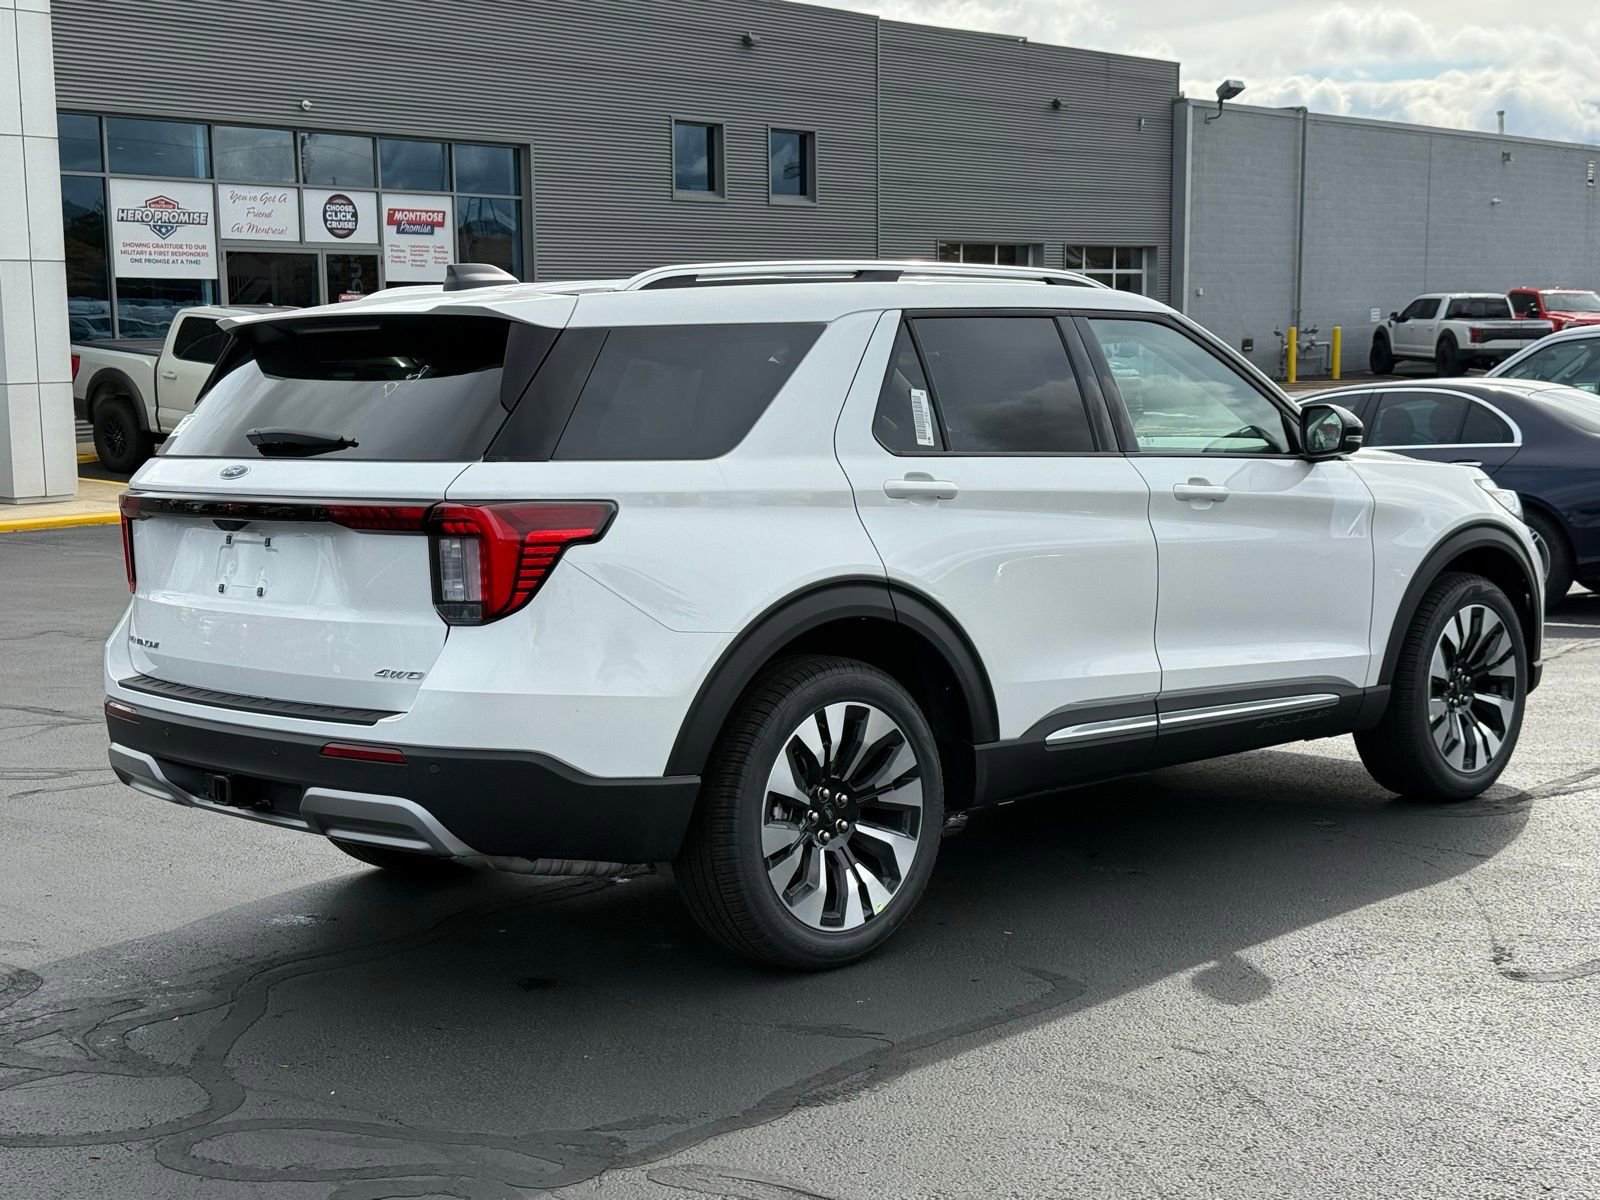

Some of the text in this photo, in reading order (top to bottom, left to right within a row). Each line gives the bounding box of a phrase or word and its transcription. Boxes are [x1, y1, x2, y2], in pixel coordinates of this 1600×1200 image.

[117, 208, 208, 225] HERO PROMISE
[246, 206, 274, 218] Friend
[326, 212, 356, 220] CLICK.
[394, 210, 444, 222] MONTROSE
[231, 222, 288, 235] At Montrose!
[326, 220, 356, 229] CRUISE!
[400, 220, 432, 233] Promise
[374, 669, 426, 680] 4WD
